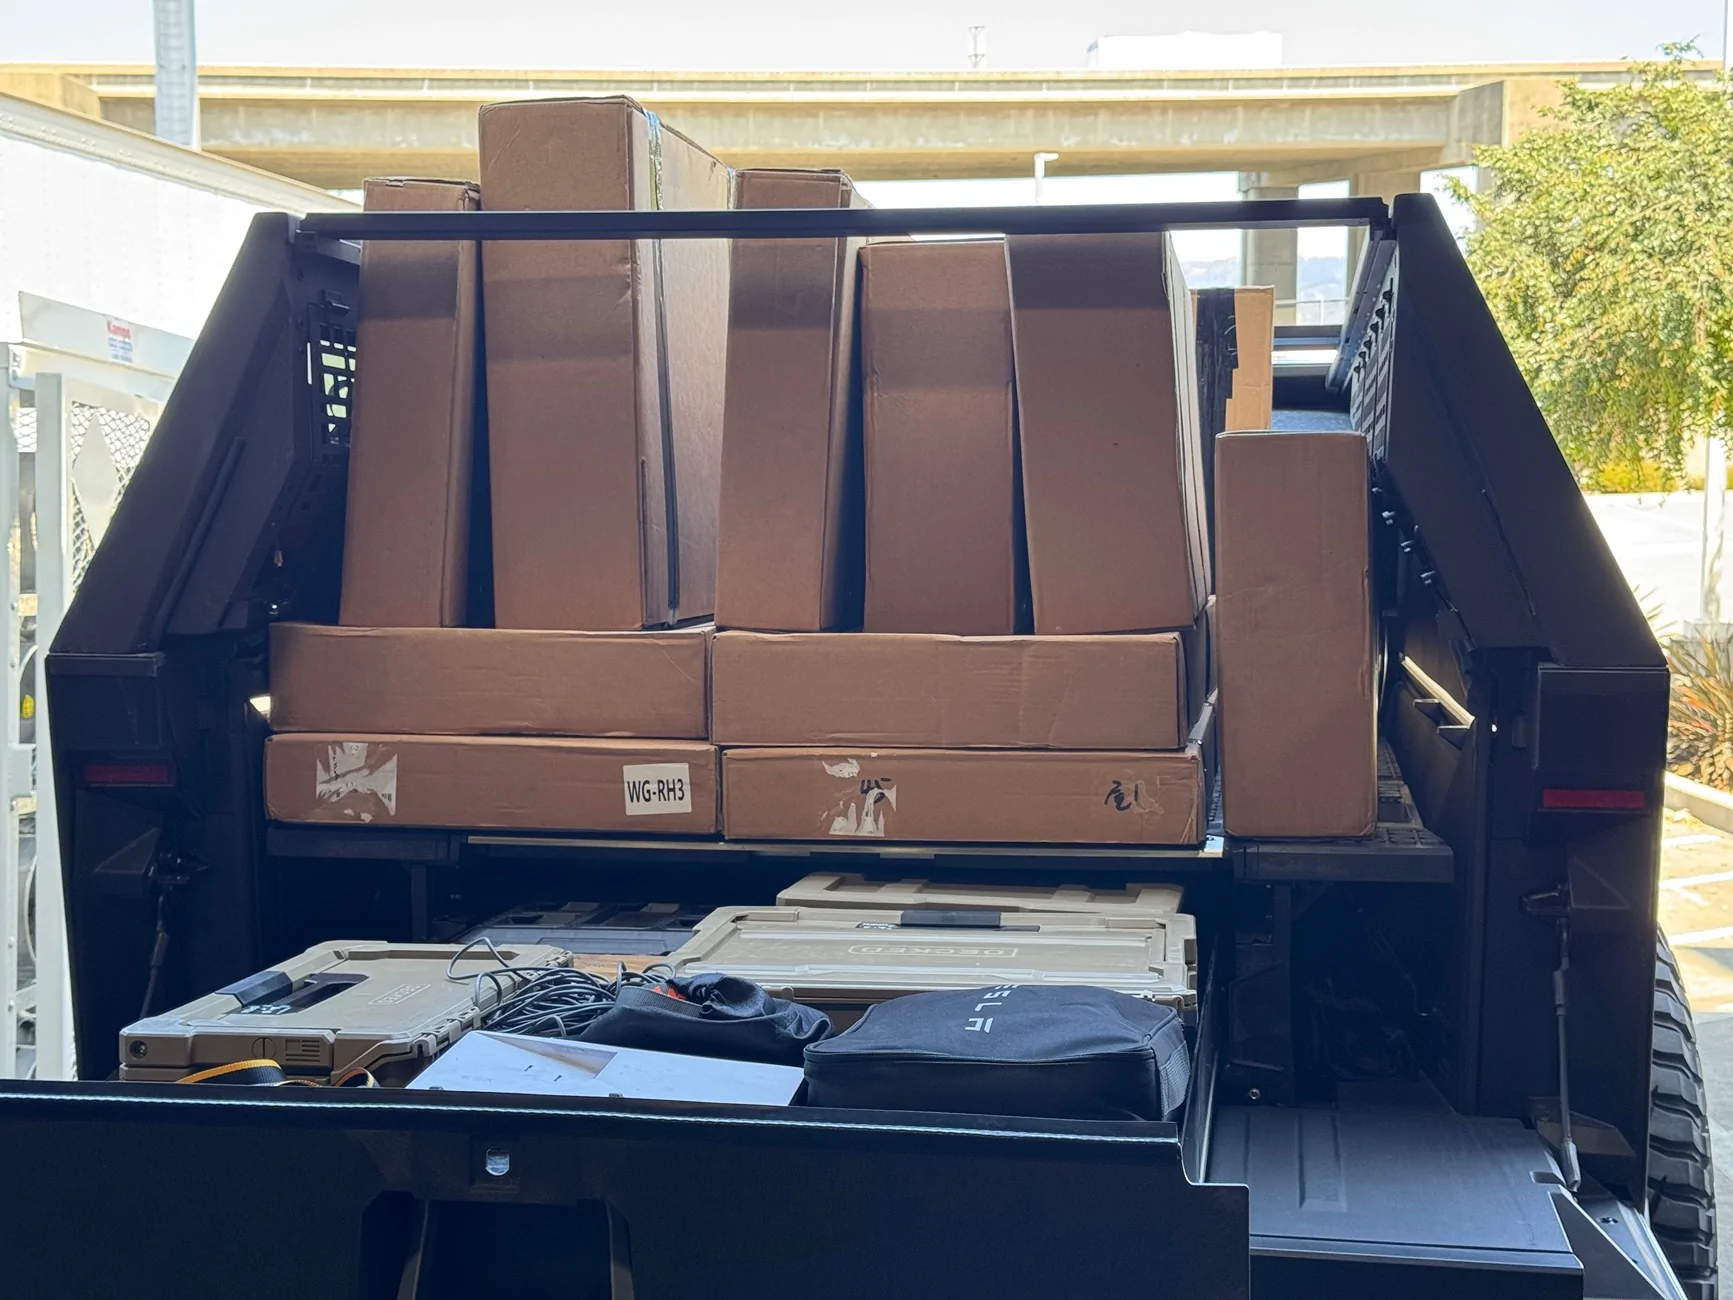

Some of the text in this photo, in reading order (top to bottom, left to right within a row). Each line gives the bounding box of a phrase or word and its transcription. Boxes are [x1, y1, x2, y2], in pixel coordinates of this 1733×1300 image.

[627, 778, 685, 803] WG-RH3
[861, 946, 1005, 956] DECKED
[964, 984, 1020, 1033] ESLA
